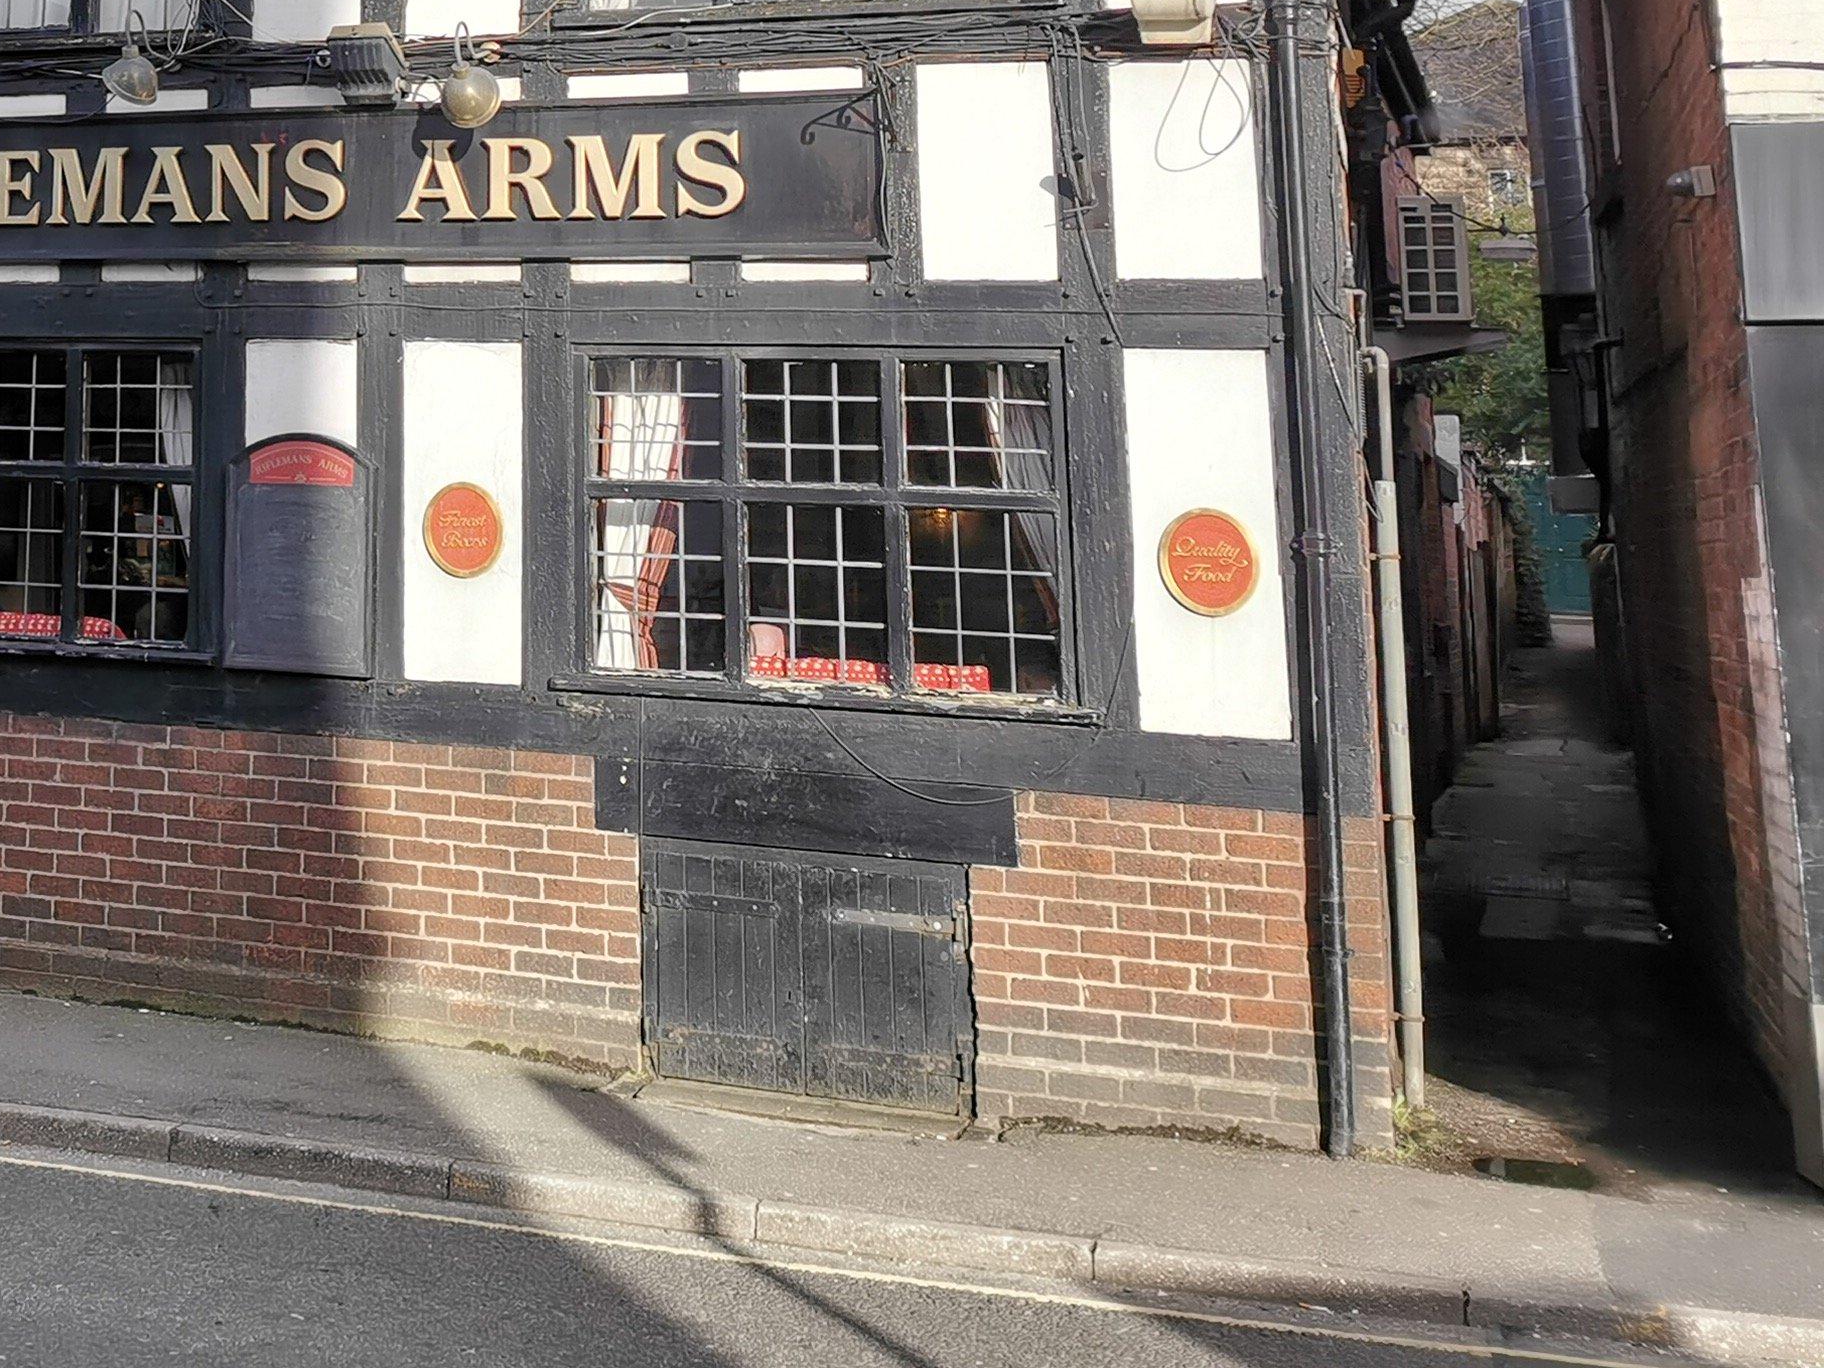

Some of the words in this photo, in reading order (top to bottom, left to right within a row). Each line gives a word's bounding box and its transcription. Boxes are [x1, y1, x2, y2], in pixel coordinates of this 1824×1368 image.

[395, 129, 747, 222] ARMS
[254, 454, 312, 475] RIFLEMANS
[318, 459, 348, 479] ARMS
[1172, 536, 1248, 567] Quality
[1183, 563, 1236, 583] Food
